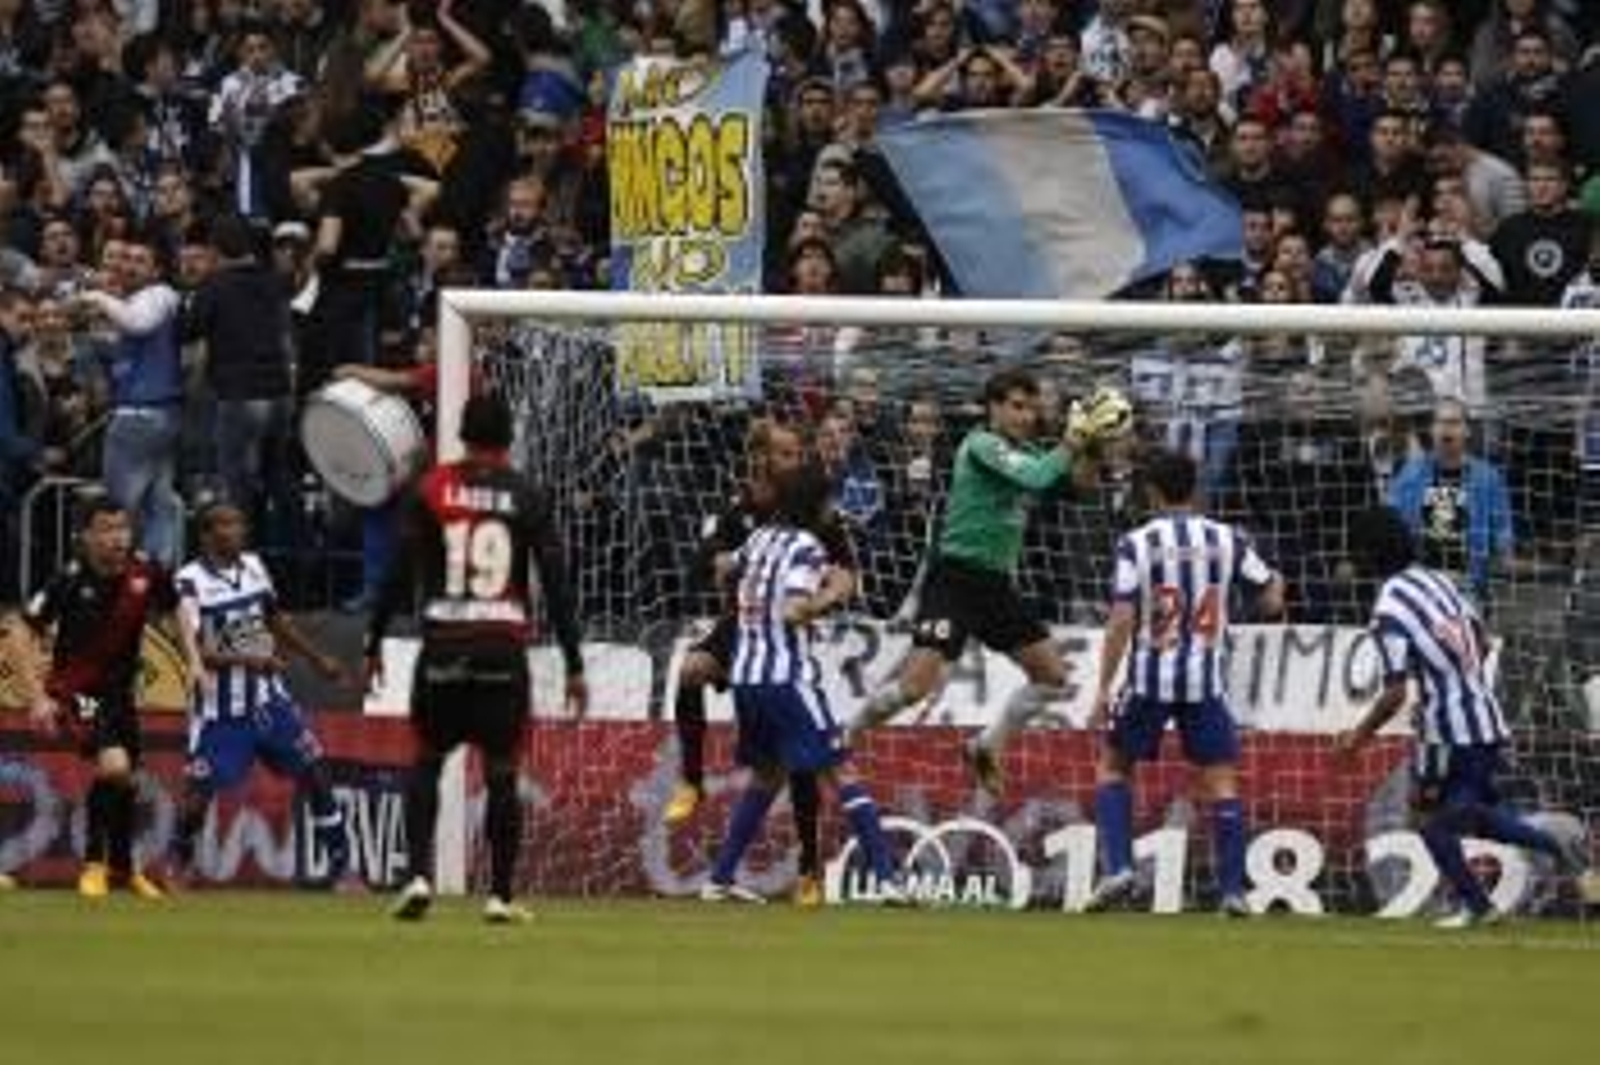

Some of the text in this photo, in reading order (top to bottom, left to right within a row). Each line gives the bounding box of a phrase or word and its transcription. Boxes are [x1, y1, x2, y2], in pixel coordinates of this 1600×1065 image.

[444, 517, 512, 598] 19
[1152, 582, 1220, 648] 24
[962, 874, 1002, 902] AL
